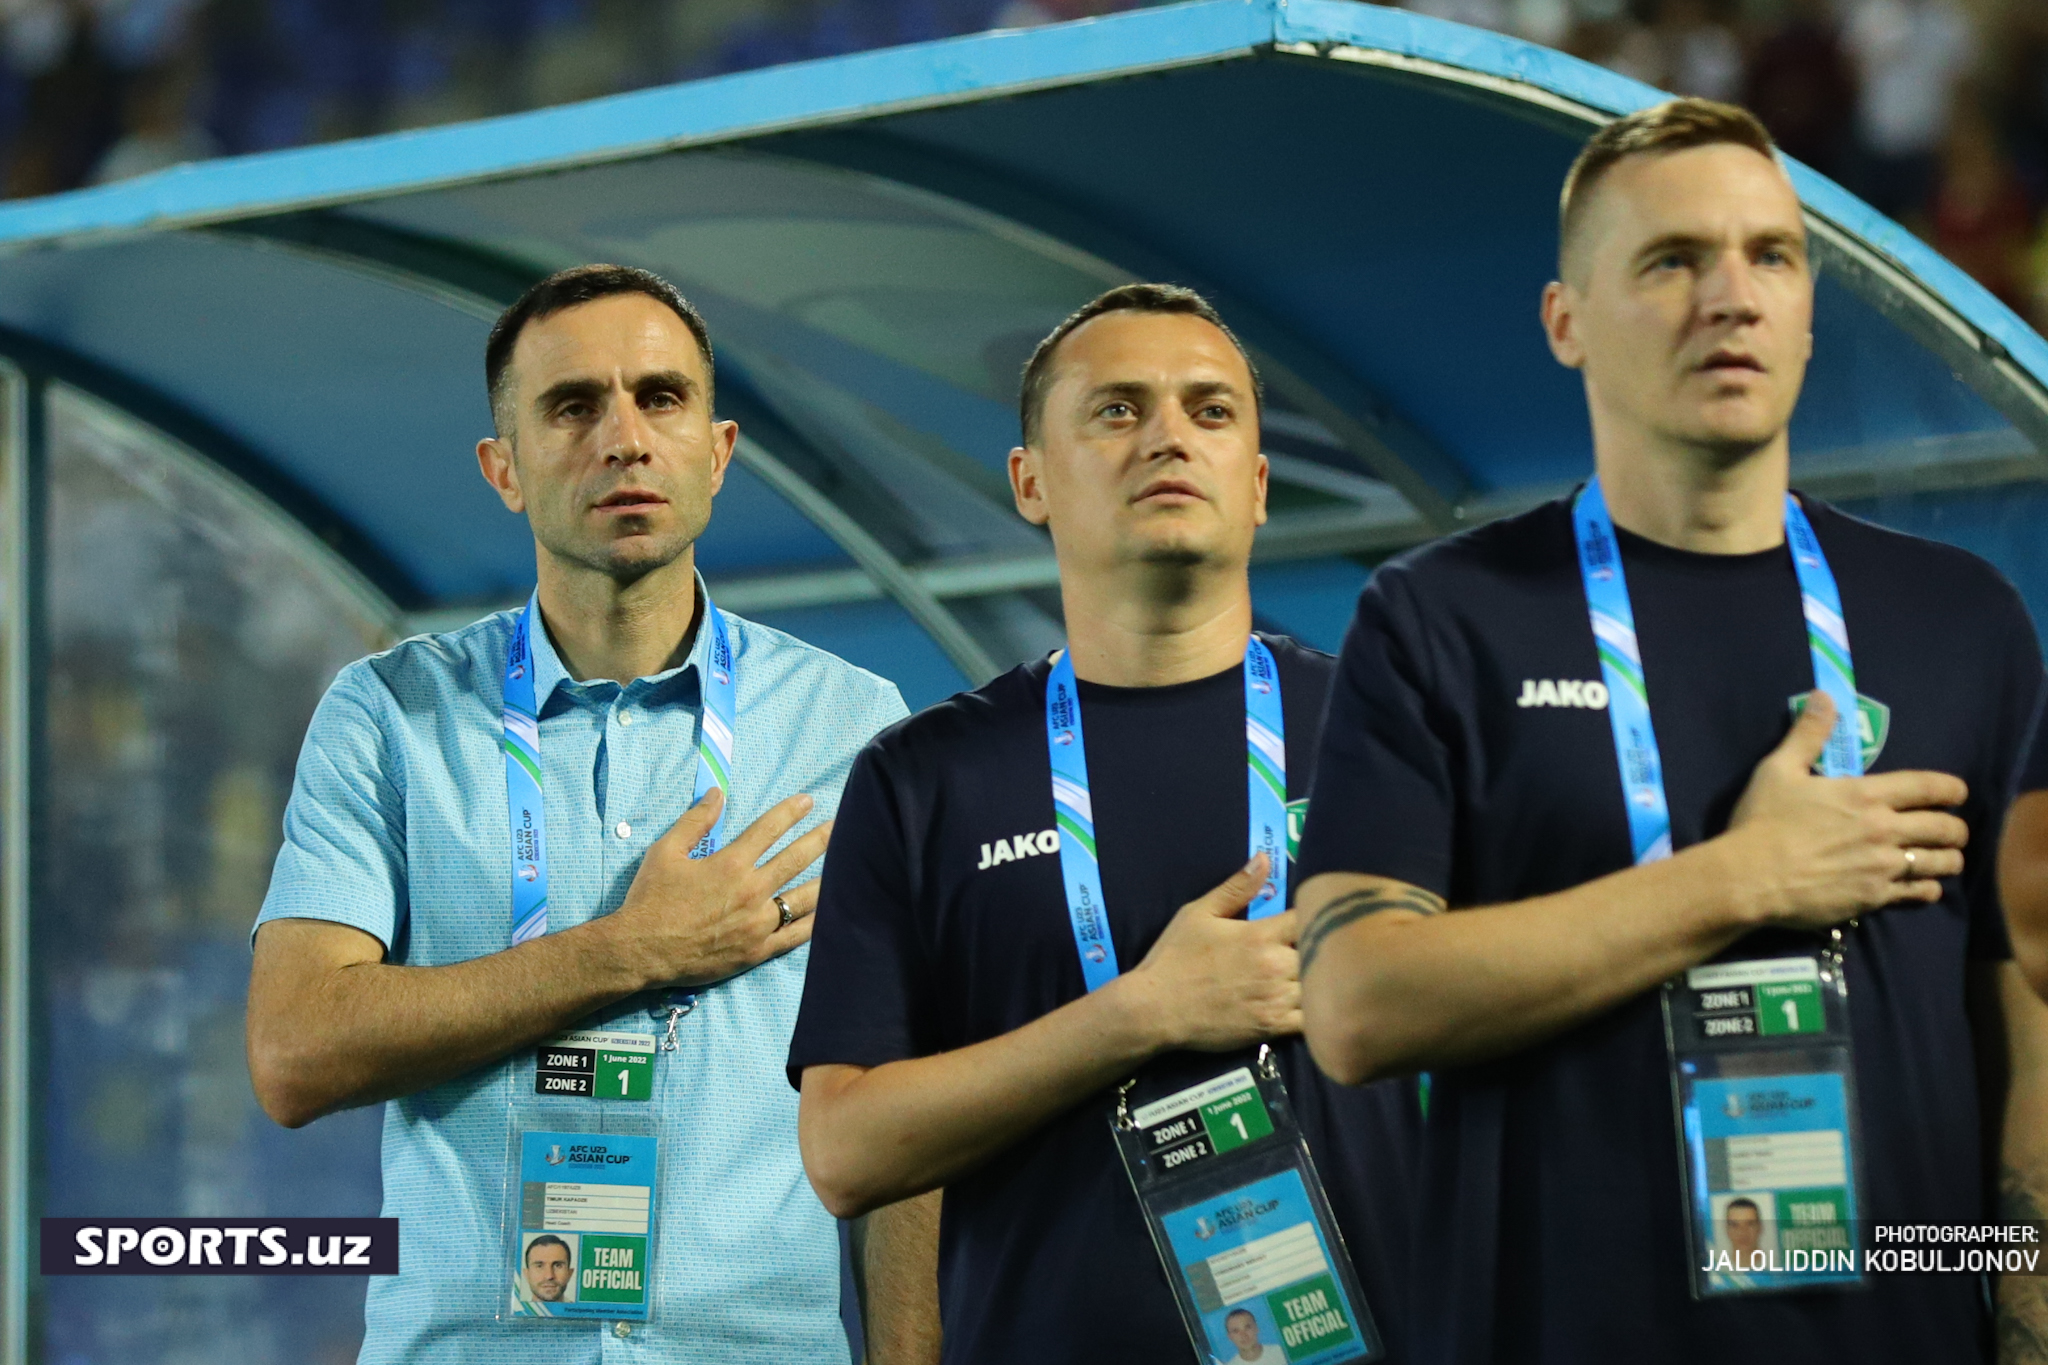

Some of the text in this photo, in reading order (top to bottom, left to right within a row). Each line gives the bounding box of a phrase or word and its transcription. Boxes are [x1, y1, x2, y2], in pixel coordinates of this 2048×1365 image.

[1516, 679, 1609, 710] JAKO
[523, 809, 533, 861] ASIAN CUP
[977, 829, 1061, 870] JAKO
[1781, 1000, 1799, 1032] 1
[569, 1034, 591, 1043] ASIAN
[547, 1054, 588, 1068] ZONE 1
[603, 1054, 647, 1064] 1 June 2022
[545, 1078, 587, 1092] ZONE 2
[618, 1069, 629, 1095] 1
[1153, 1117, 1197, 1144] ZONE 1
[1230, 1112, 1249, 1140] 1
[568, 1153, 631, 1164] ASIAN CUP
[569, 1145, 607, 1154] AFC U23
[1162, 1141, 1207, 1168] ZONE 2
[1254, 1199, 1279, 1215] CUP
[594, 1247, 634, 1268] TEAM
[582, 1269, 642, 1290] OFFICIAL
[1282, 1289, 1329, 1322] TEAM
[1282, 1308, 1348, 1347] OFFICIAL
